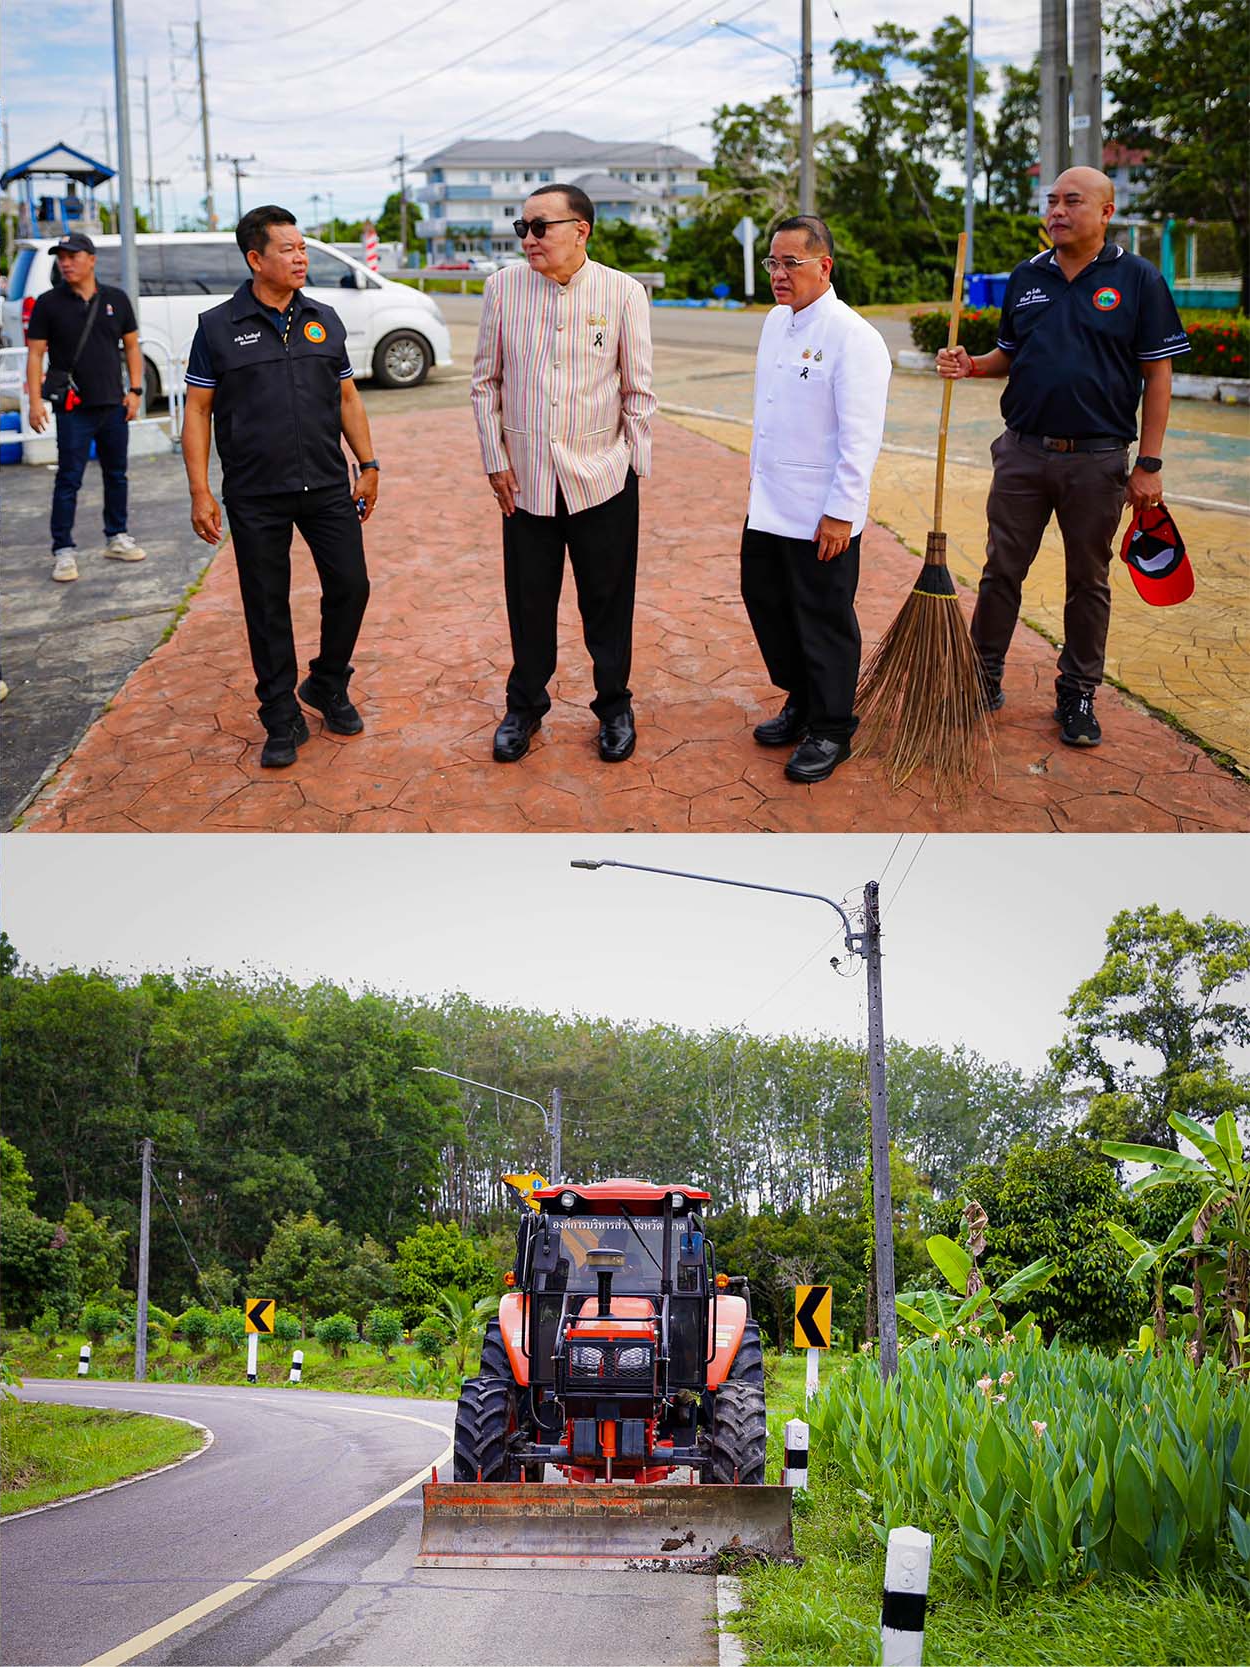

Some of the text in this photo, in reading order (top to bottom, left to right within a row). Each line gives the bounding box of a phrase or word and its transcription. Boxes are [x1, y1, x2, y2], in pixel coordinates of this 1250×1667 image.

[552, 1217, 685, 1231] องค์การบริหารส่วจังหวัดาด
